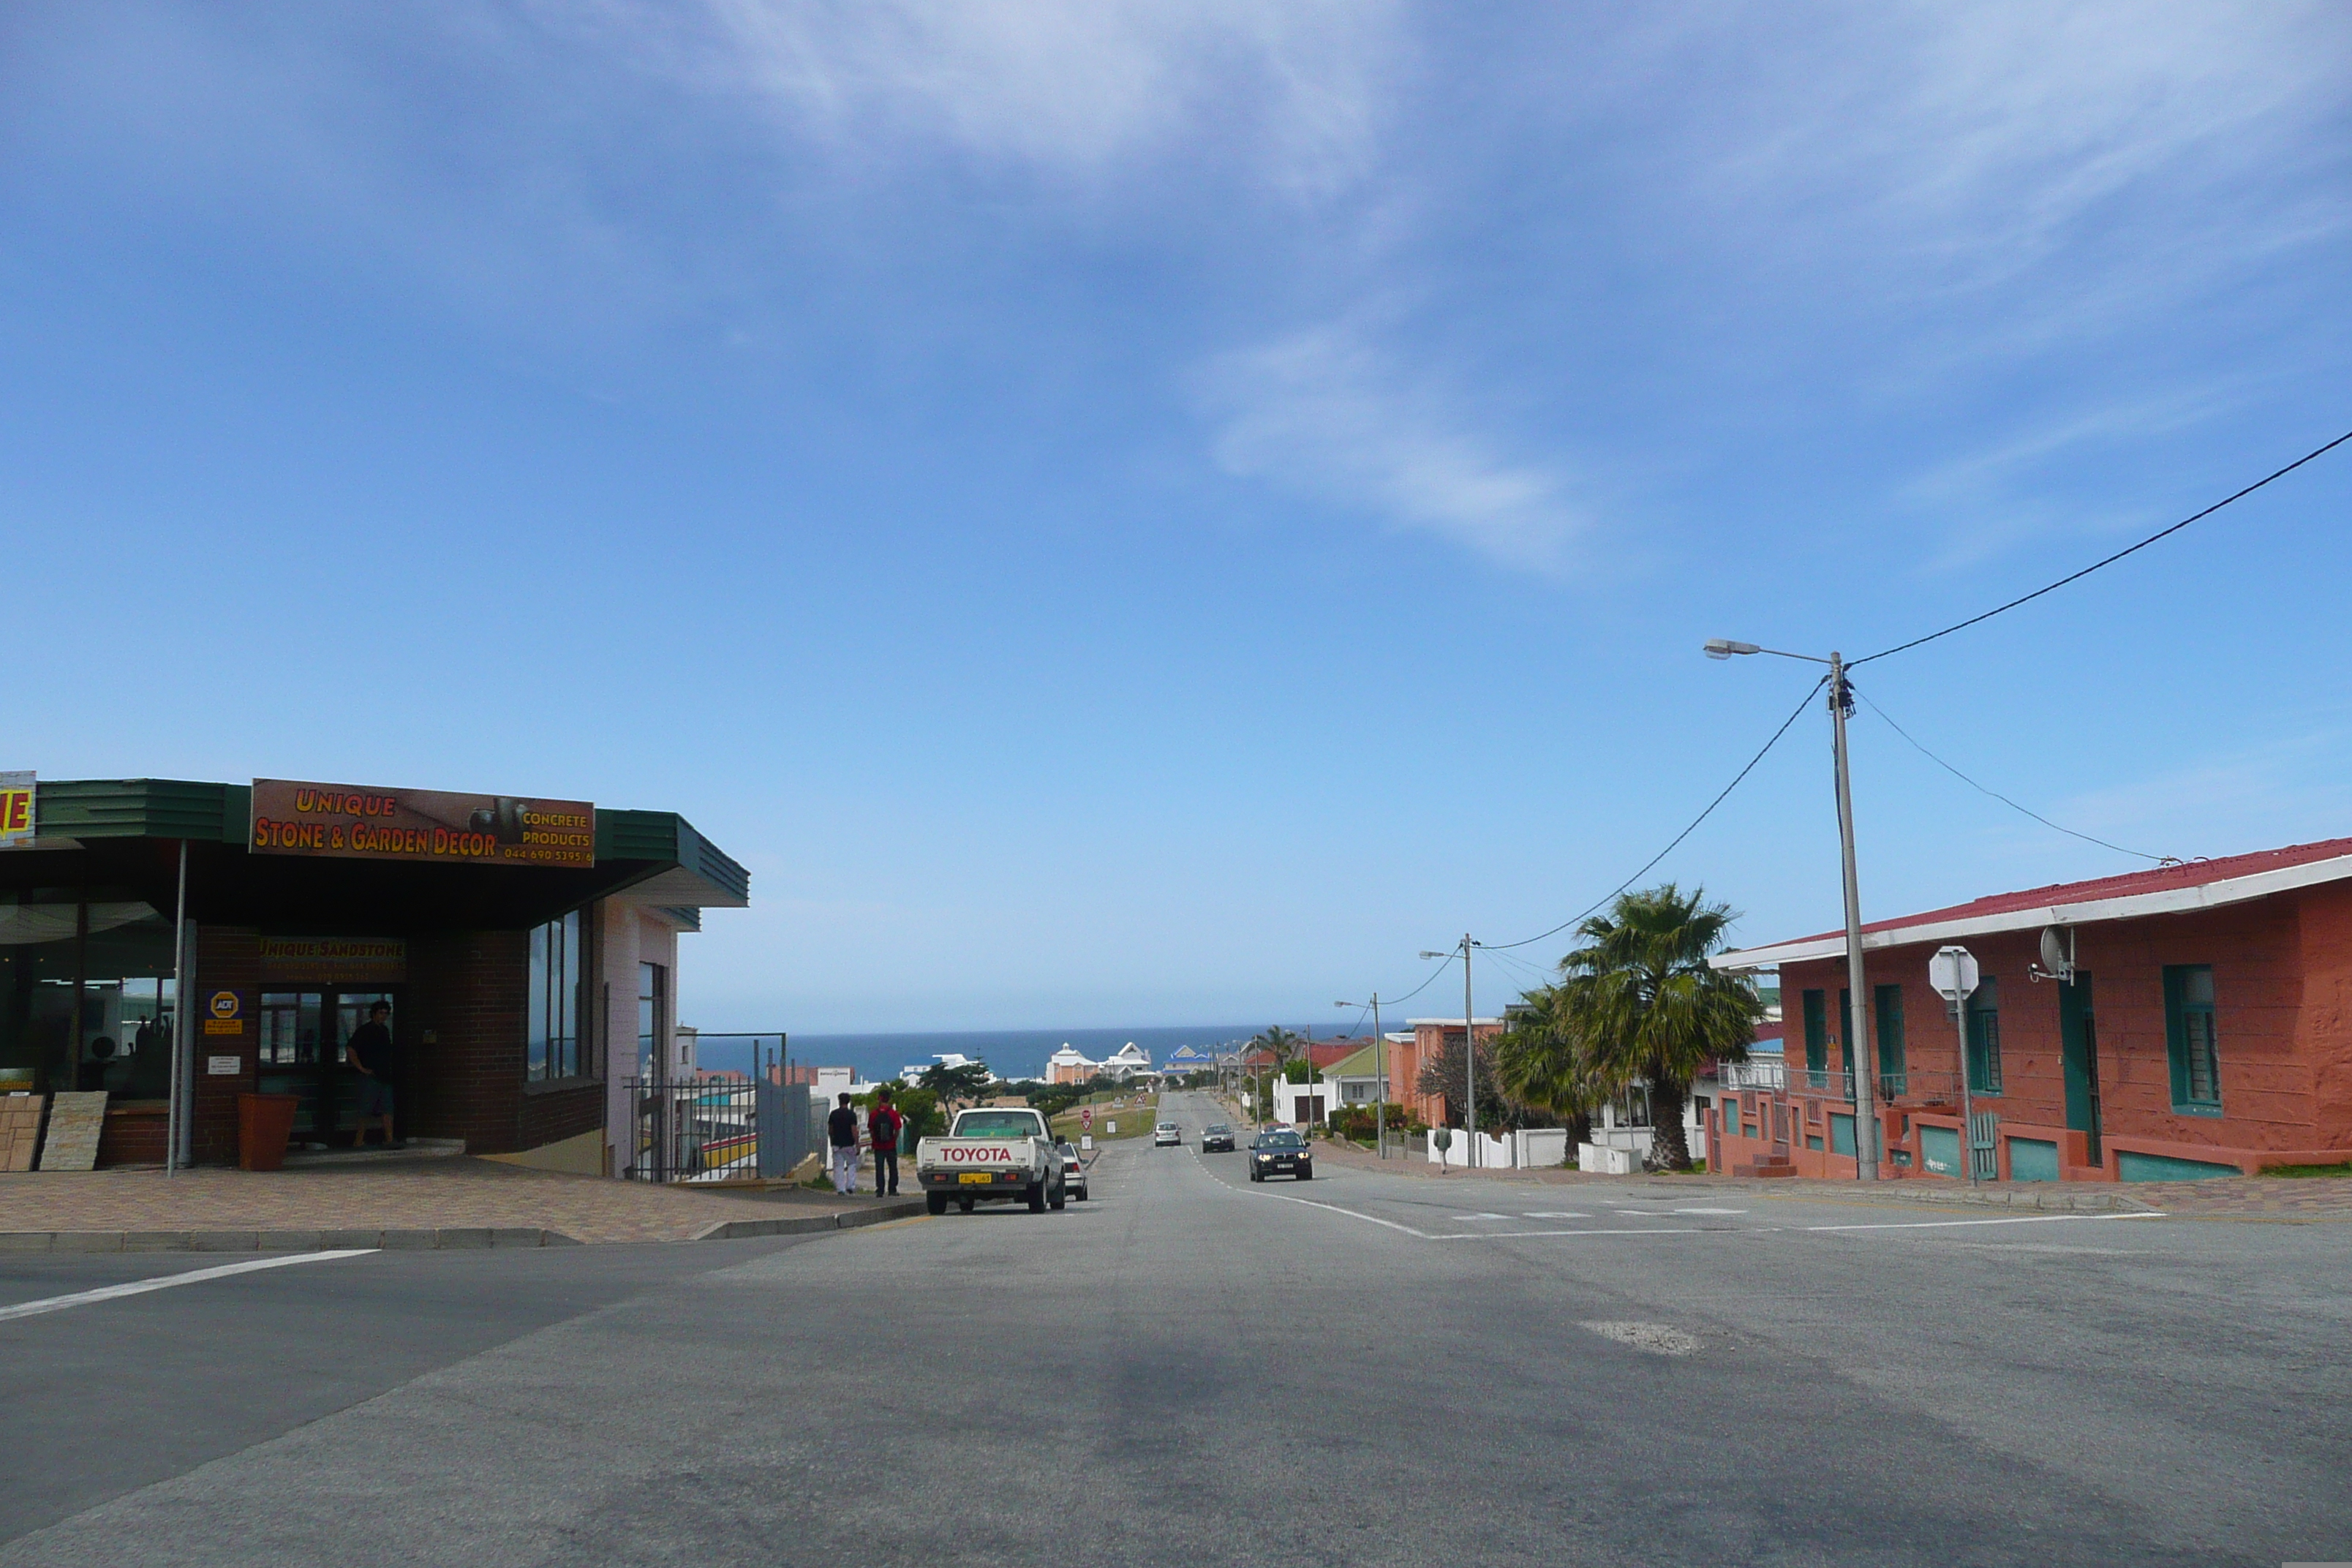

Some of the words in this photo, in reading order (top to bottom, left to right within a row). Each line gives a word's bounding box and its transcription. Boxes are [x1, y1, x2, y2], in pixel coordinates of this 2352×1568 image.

[295, 789, 396, 817] UNIQUE
[522, 812, 587, 827] CONCRETE
[255, 816, 325, 850] STONE
[331, 824, 345, 849] &
[350, 821, 429, 855] GARDEN
[433, 828, 496, 856] DECOR
[522, 832, 590, 846] PRODUCTS
[504, 848, 527, 859] 044
[530, 850, 552, 860] 690
[257, 938, 314, 957] UNIQUE
[319, 940, 404, 957] SANDSTONE
[215, 1000, 233, 1009] ADT
[940, 1147, 1012, 1162] TOYOTA
